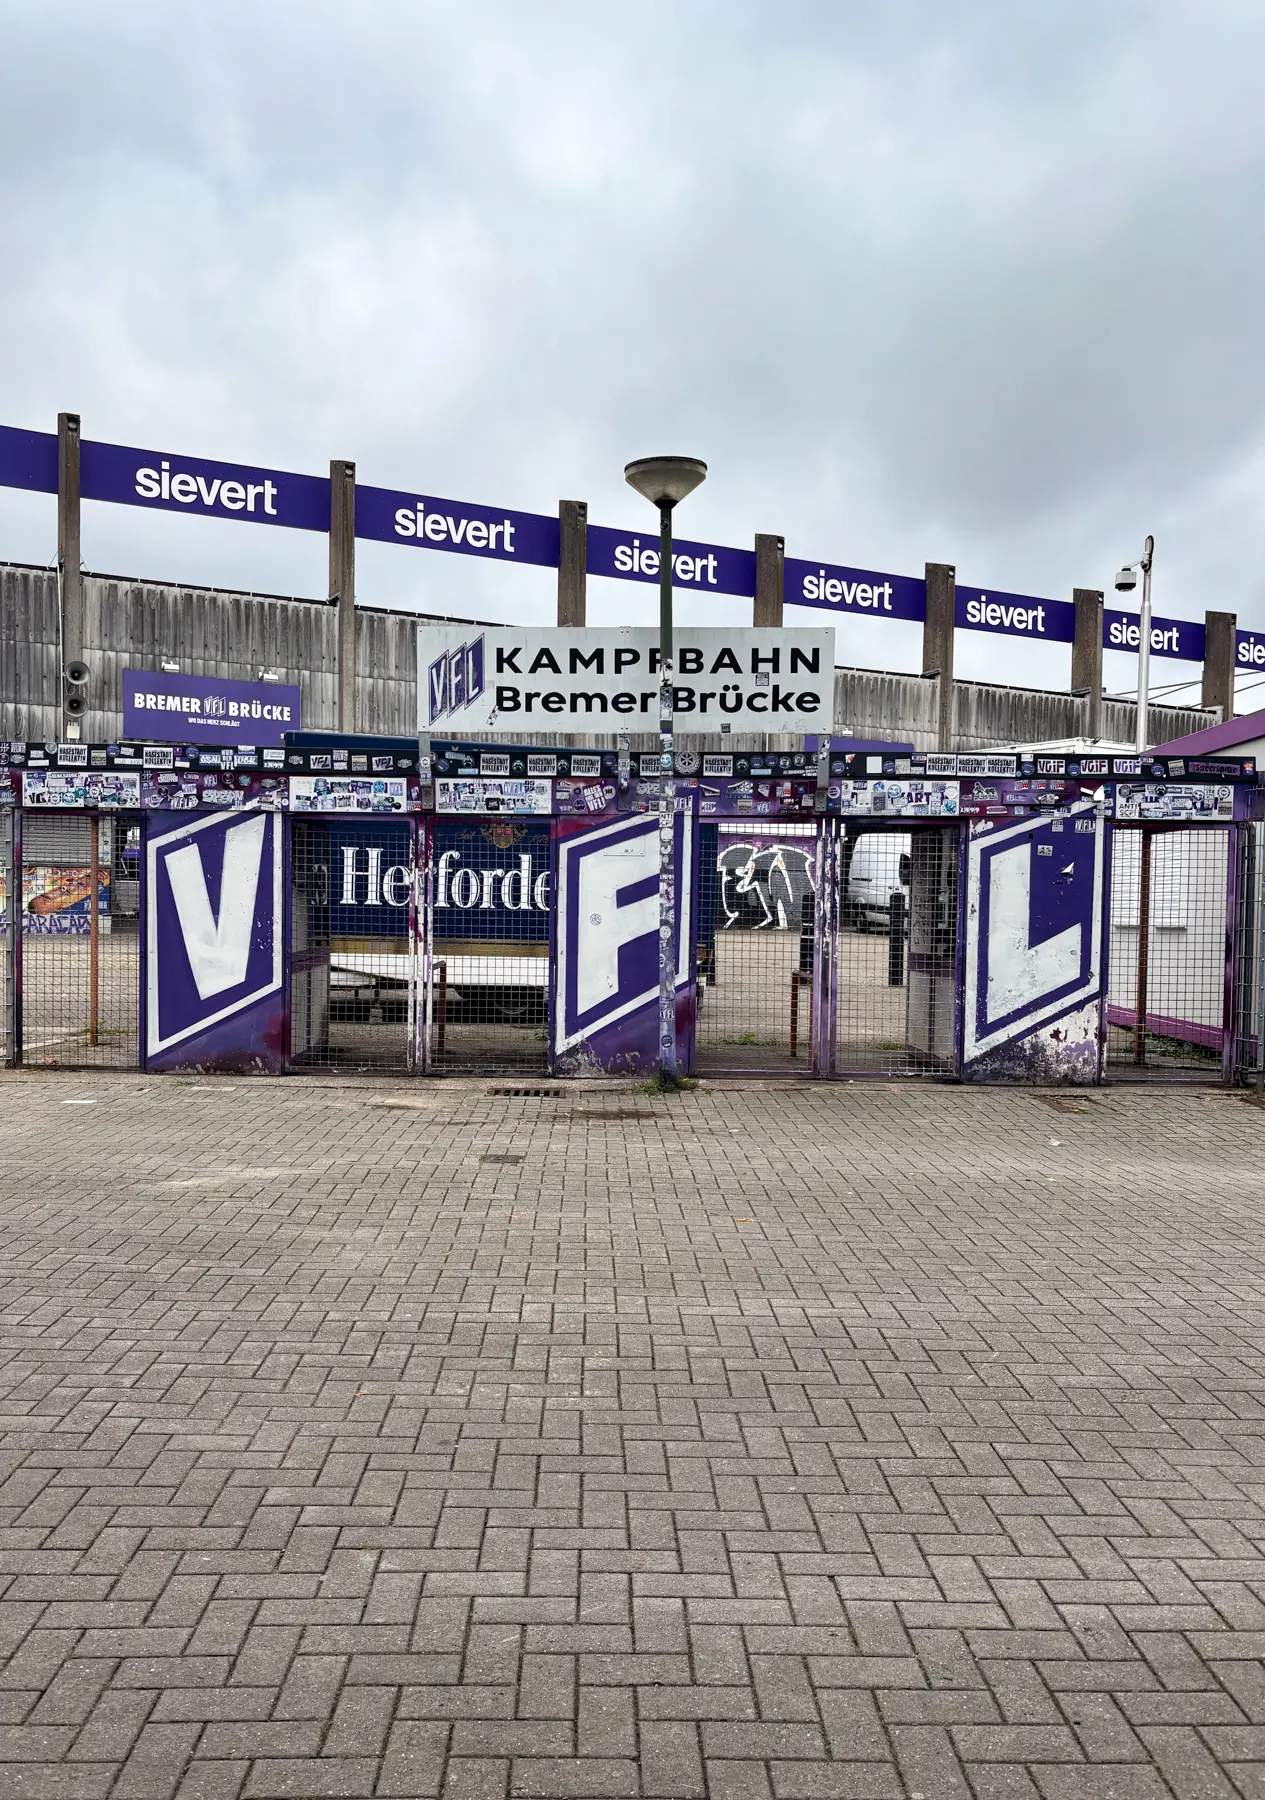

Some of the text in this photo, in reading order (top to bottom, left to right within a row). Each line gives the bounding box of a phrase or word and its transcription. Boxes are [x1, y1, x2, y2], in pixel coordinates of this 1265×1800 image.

[135, 461, 277, 515] sievert
[394, 502, 515, 552] sievert
[802, 569, 893, 610] sievert
[966, 595, 1045, 632] sievert
[1109, 617, 1179, 652] sieert
[134, 692, 201, 714] BREMER
[228, 700, 291, 721] BRÜCKE
[496, 684, 821, 713] Bremer Brücke
[220, 762, 234, 770] VFL
[928, 757, 955, 765] HASESTADT
[959, 758, 986, 766] HASESTADT
[959, 765, 986, 773] KOLLEKTIV
